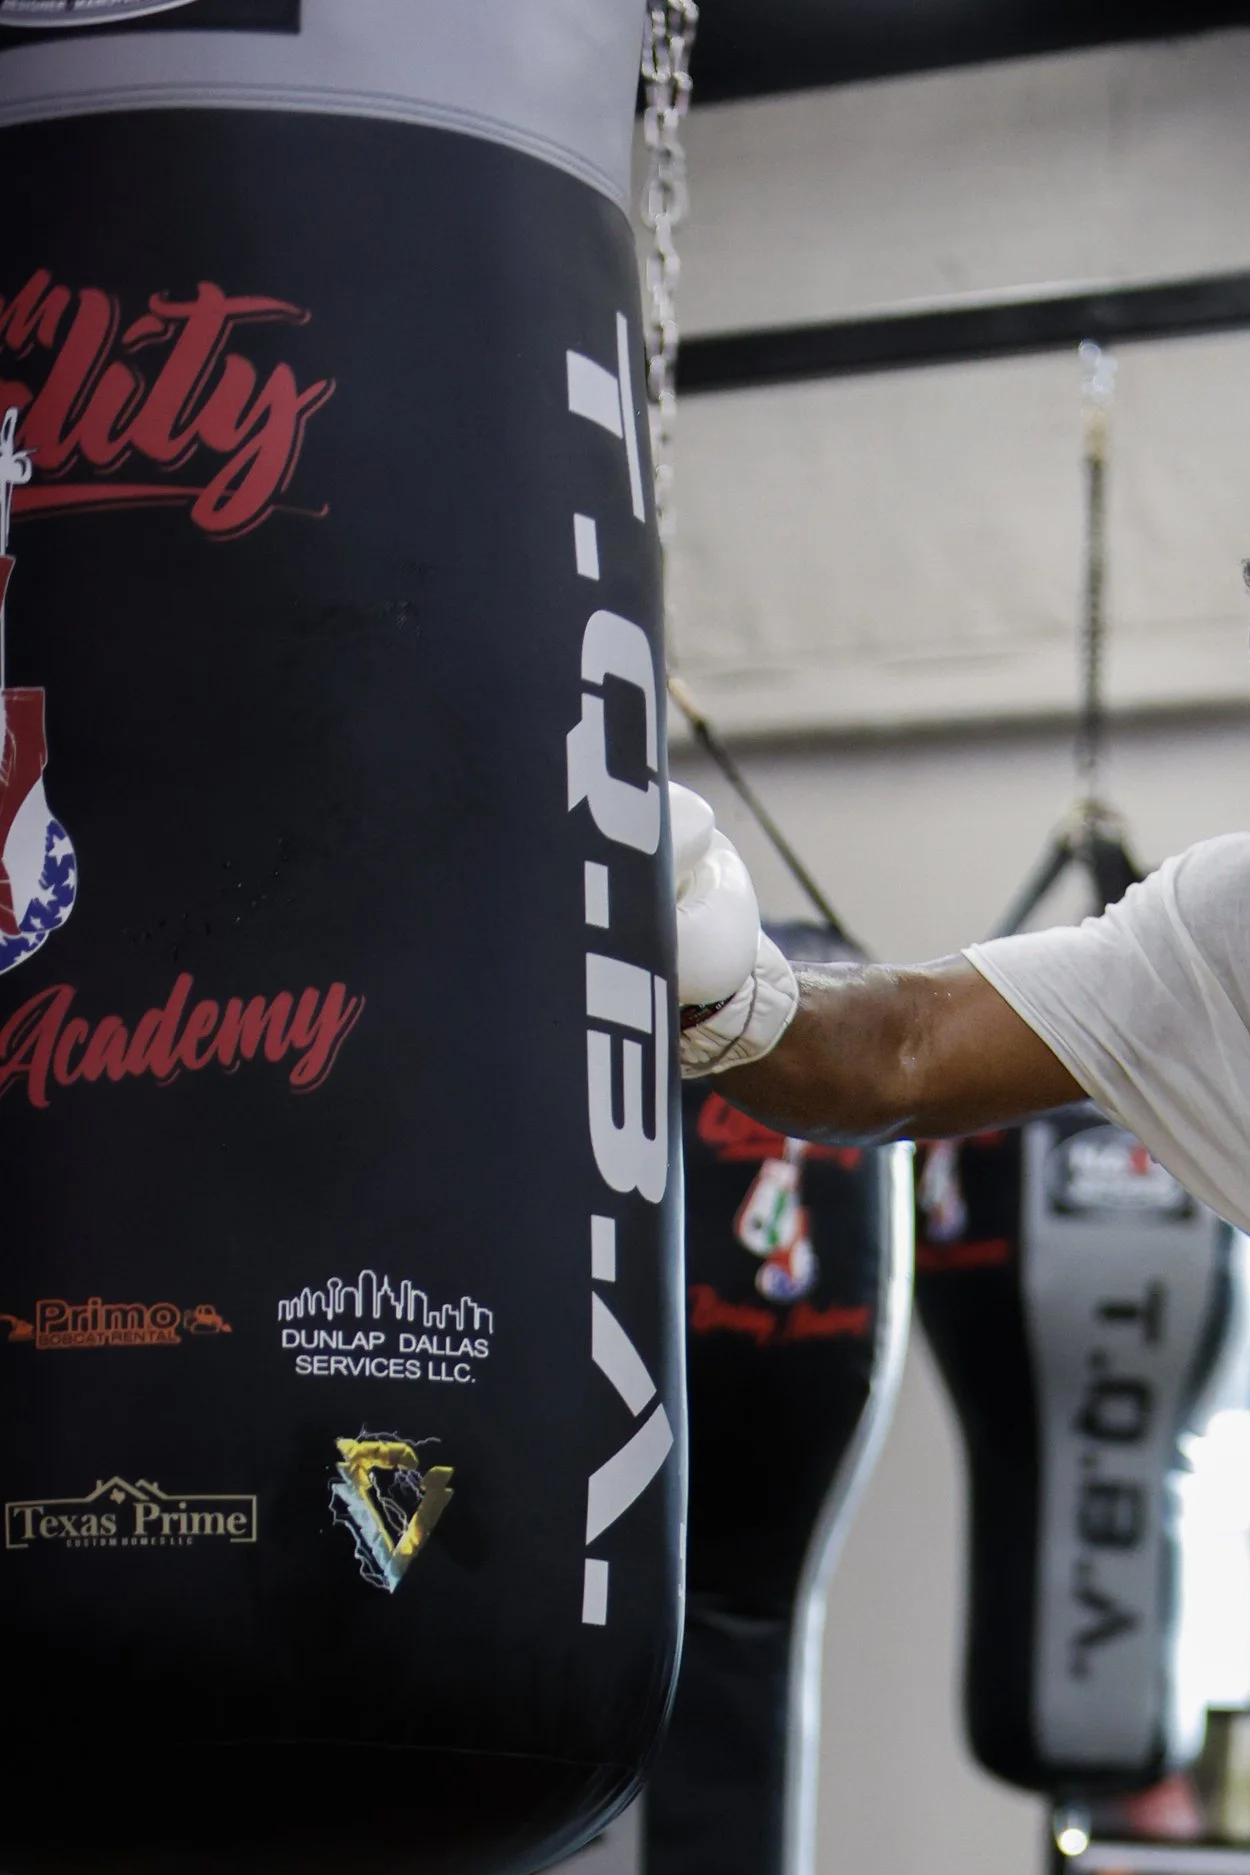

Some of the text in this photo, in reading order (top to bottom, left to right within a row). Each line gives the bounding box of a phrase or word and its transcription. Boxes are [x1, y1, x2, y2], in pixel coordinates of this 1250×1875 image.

[0, 972, 364, 1107] Academy
[36, 1297, 182, 1335] Primo
[281, 1329, 489, 1358] DUNLAP DALLAS
[295, 1355, 476, 1384] SERVICES LLC.
[13, 1501, 248, 1540] Texas Prime
